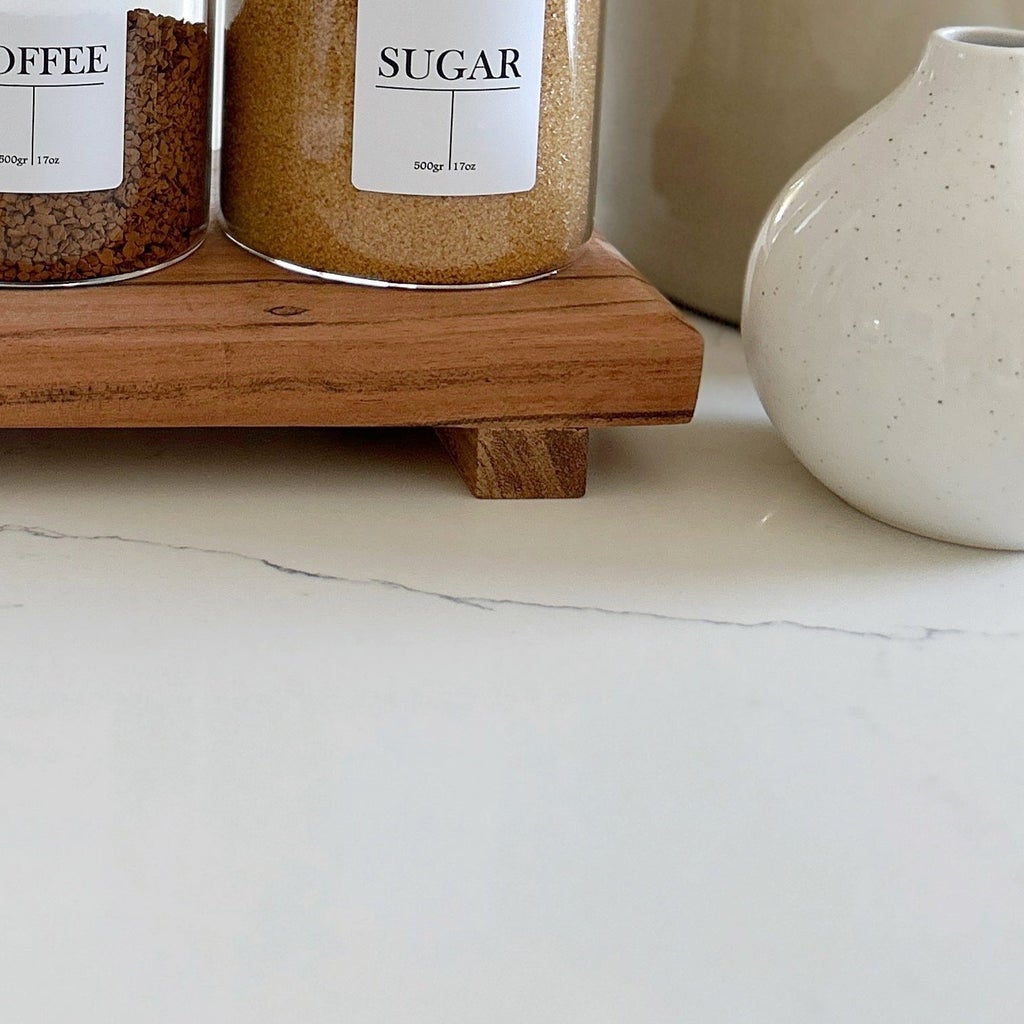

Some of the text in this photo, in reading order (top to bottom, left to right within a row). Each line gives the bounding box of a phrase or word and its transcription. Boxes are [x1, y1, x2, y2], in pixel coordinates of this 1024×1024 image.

[377, 45, 523, 81] SUGAR
[36, 155, 61, 165] 17oz
[413, 160, 477, 174] 500gr 17oz
